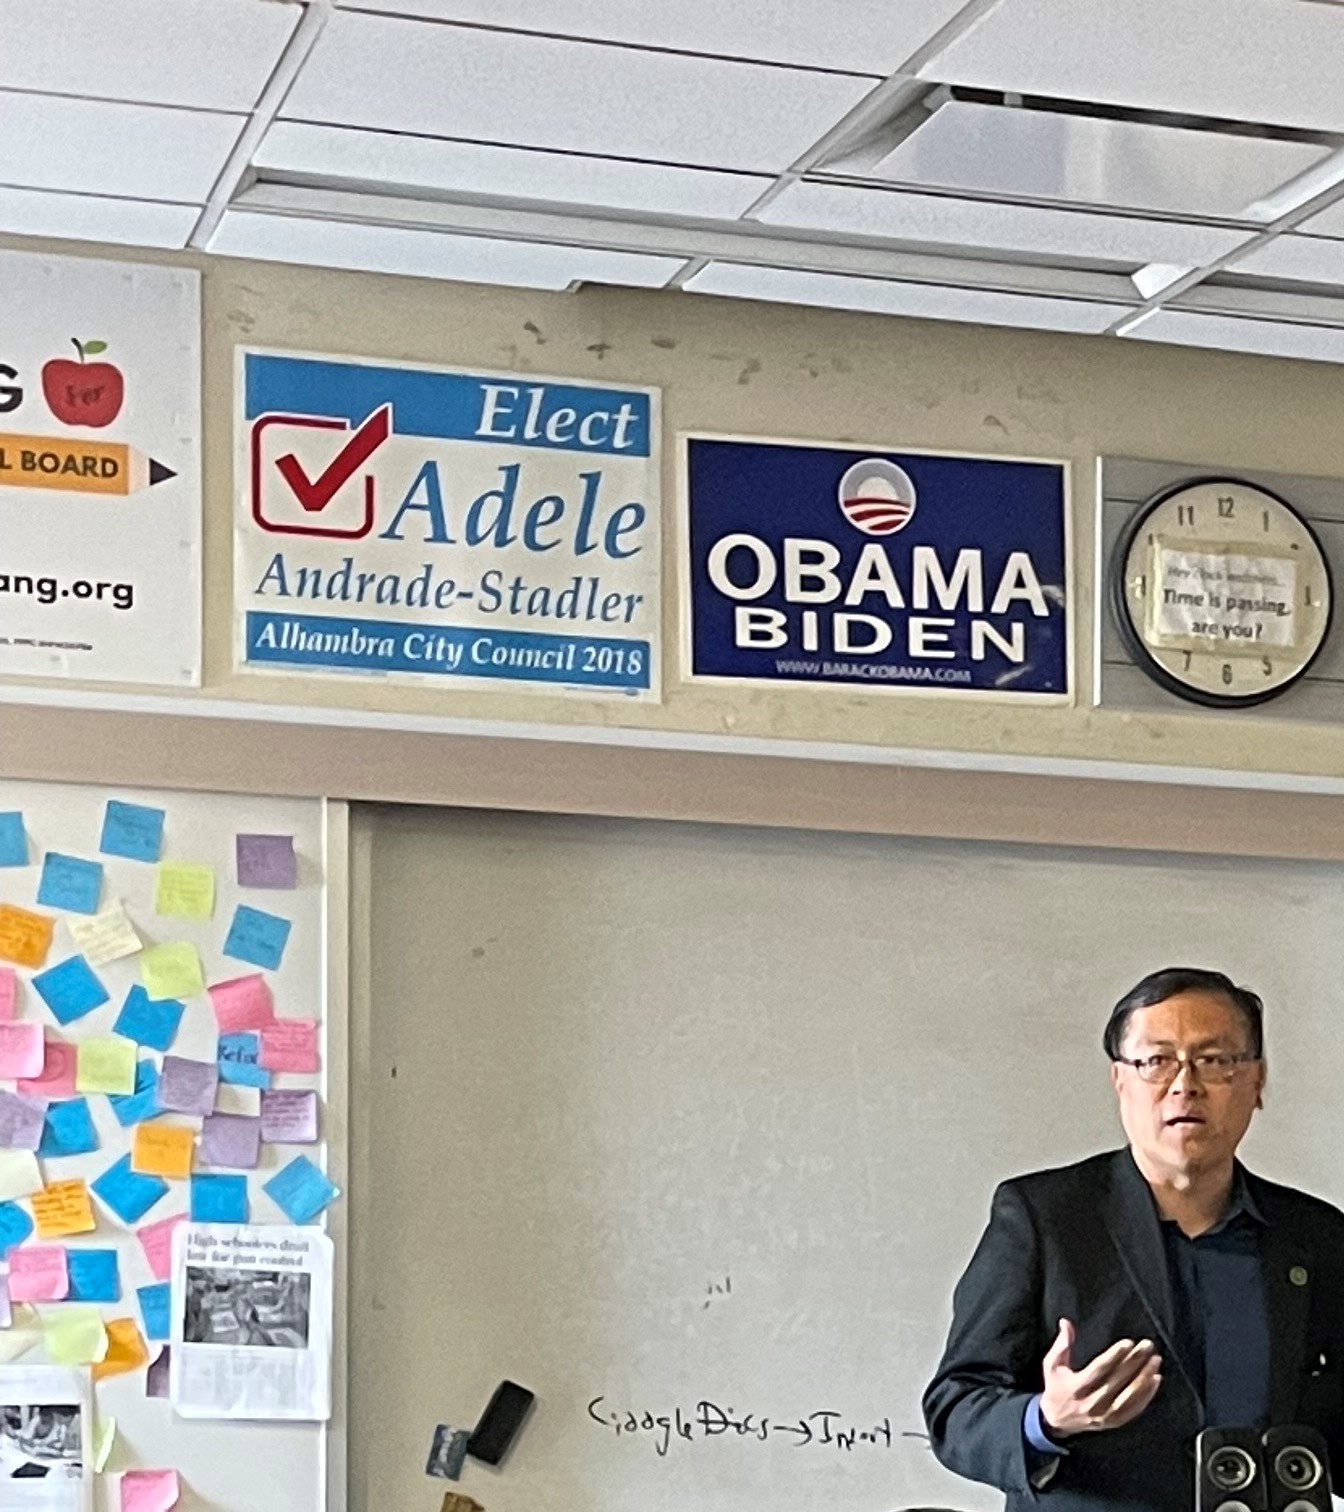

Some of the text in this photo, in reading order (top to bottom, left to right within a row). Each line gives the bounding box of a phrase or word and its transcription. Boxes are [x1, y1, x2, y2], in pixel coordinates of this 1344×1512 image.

[475, 383, 640, 449] Elect
[20, 450, 119, 478] BOARD
[378, 460, 646, 559] Adele
[1178, 505, 1194, 526] 11
[1218, 497, 1234, 518] 12
[254, 553, 644, 624] Andrade-Stadler
[707, 533, 1049, 616] OBAMA
[1164, 589, 1204, 607] Time
[1209, 592, 1221, 608] is
[255, 622, 642, 676] Alhambra City Council 2018
[735, 606, 1025, 663] BIDEN
[1192, 621, 1263, 640] are you?
[1222, 664, 1232, 685] 6
